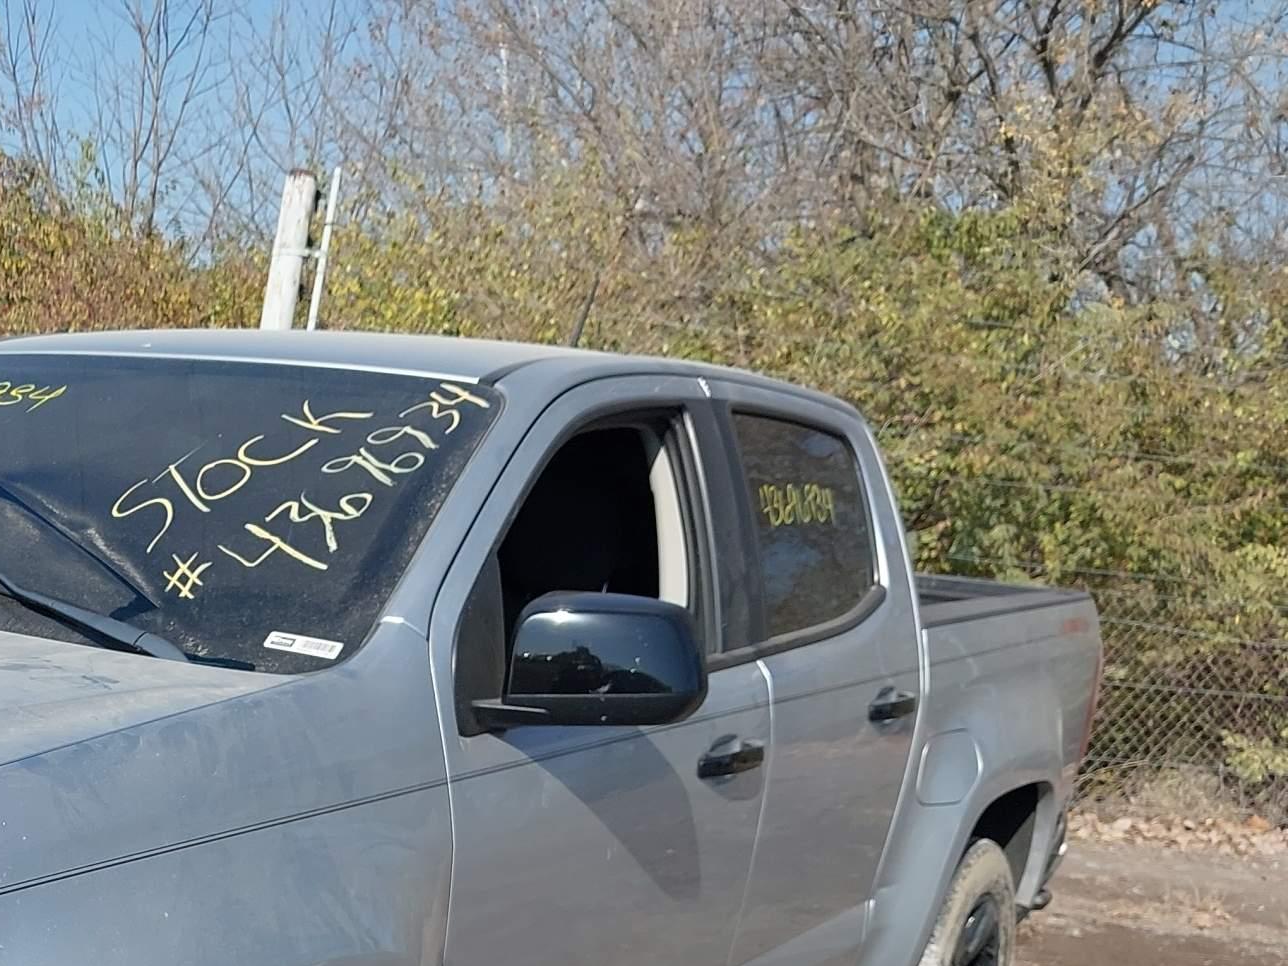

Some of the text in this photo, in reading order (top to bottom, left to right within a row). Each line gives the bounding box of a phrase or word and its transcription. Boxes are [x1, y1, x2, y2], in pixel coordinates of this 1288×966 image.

[112, 400, 374, 553] STOCK
[163, 382, 490, 600] # 43696934
